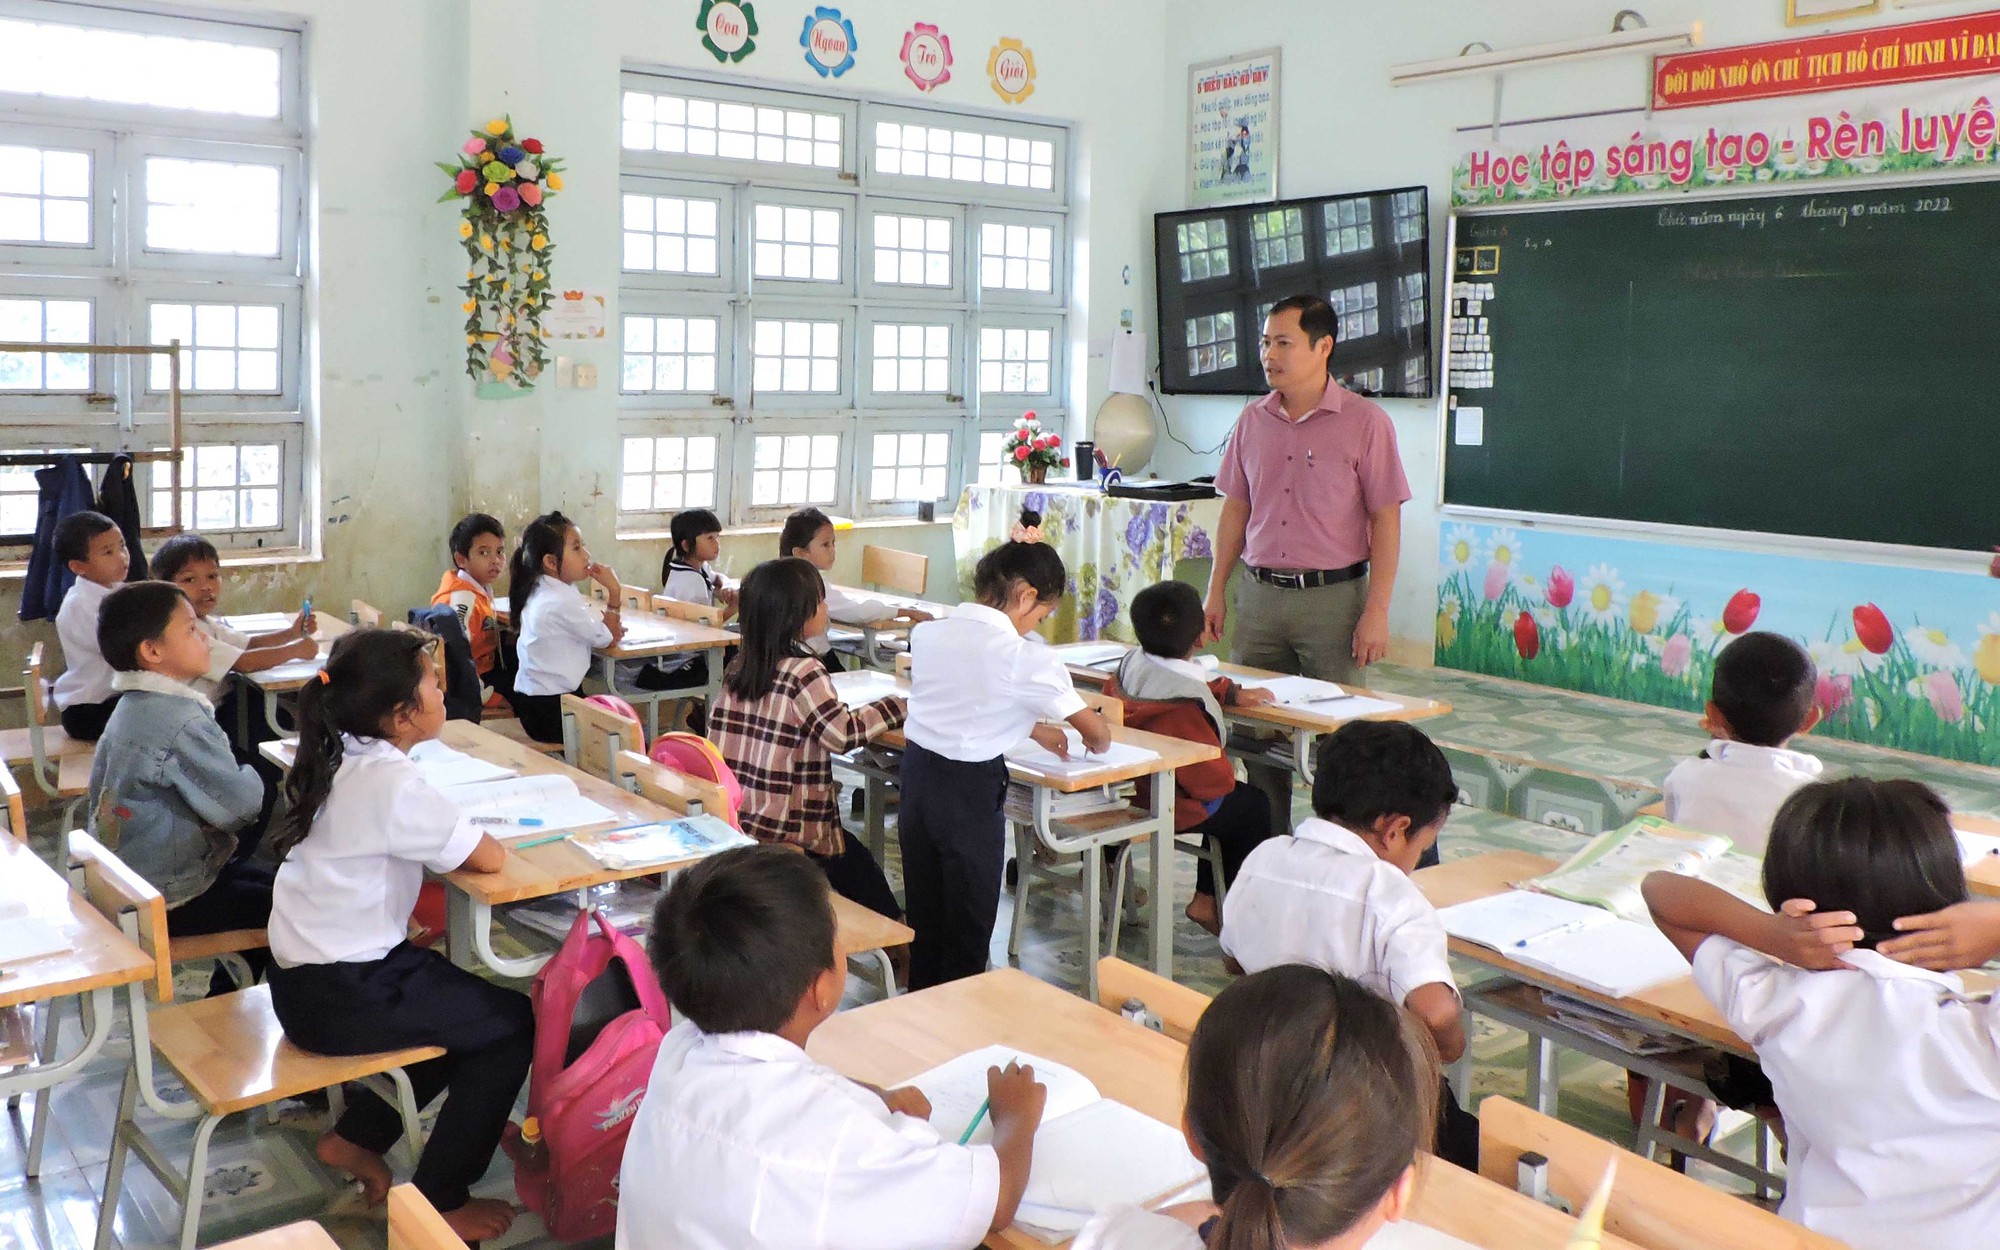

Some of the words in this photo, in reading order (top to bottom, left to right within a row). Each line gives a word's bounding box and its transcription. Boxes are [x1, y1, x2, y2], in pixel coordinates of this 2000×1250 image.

[715, 12, 739, 36] Con
[812, 28, 846, 53] Ngoan
[1807, 51, 1842, 84] TỊCH
[1846, 36, 1868, 73] HỒ
[1872, 37, 1900, 71] CHÍ
[1903, 39, 1946, 67] MINH
[1469, 150, 1530, 198] Học
[1540, 139, 1596, 193] tập
[1606, 130, 1693, 185] sáng
[1705, 127, 1770, 180] tạo
[1808, 110, 1885, 161] Rèn
[1901, 95, 2000, 161] luyệ
[1728, 207, 1765, 229] ngày
[1775, 205, 1784, 219] 6
[1914, 197, 1953, 213] 2022
